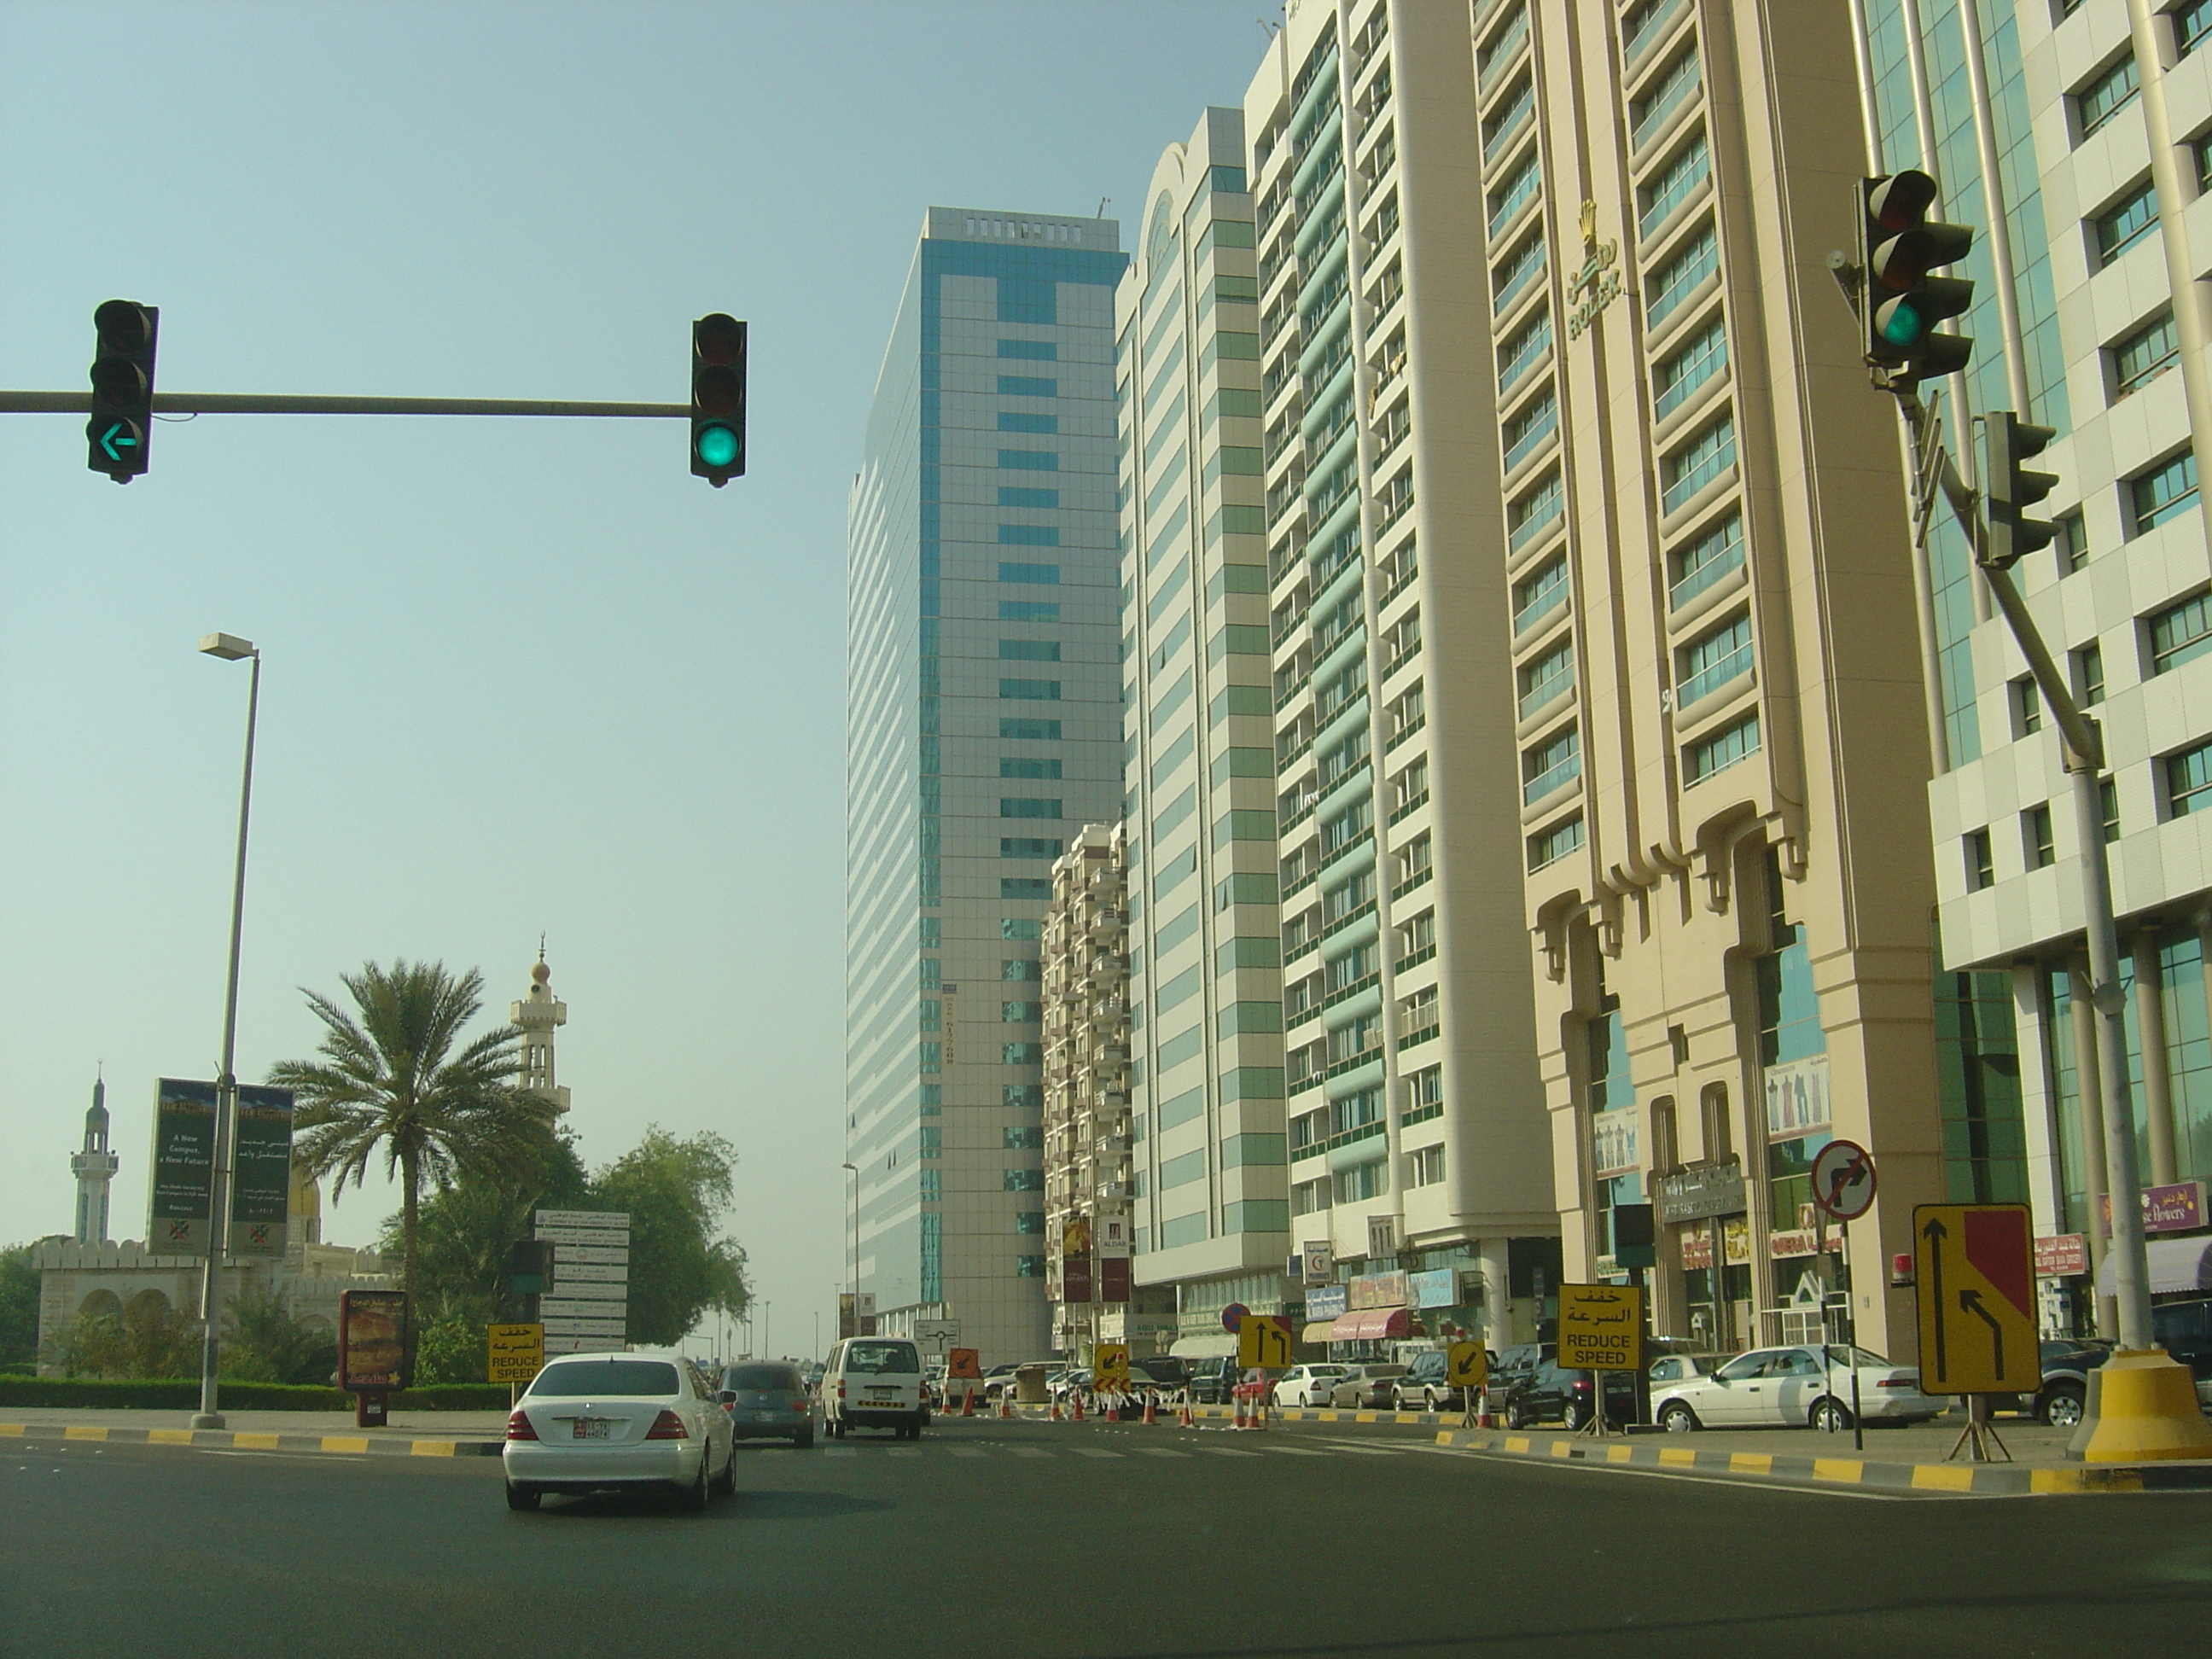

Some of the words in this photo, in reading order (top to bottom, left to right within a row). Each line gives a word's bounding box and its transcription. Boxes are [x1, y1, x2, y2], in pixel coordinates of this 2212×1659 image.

[1567, 268, 1622, 341] ROLEX
[166, 1155, 183, 1164] New
[184, 1156, 209, 1165] Future
[2153, 1202, 2185, 1222] flowers
[1574, 1290, 1621, 1303] خفف
[1567, 1307, 1630, 1325] السرعة
[499, 1326, 531, 1336] خفف
[492, 1337, 540, 1353] السرعة
[1567, 1334, 1630, 1348] REDUCE
[492, 1356, 538, 1366] REDUCE
[1575, 1350, 1626, 1364] SPEED
[498, 1368, 534, 1379] SPEED
